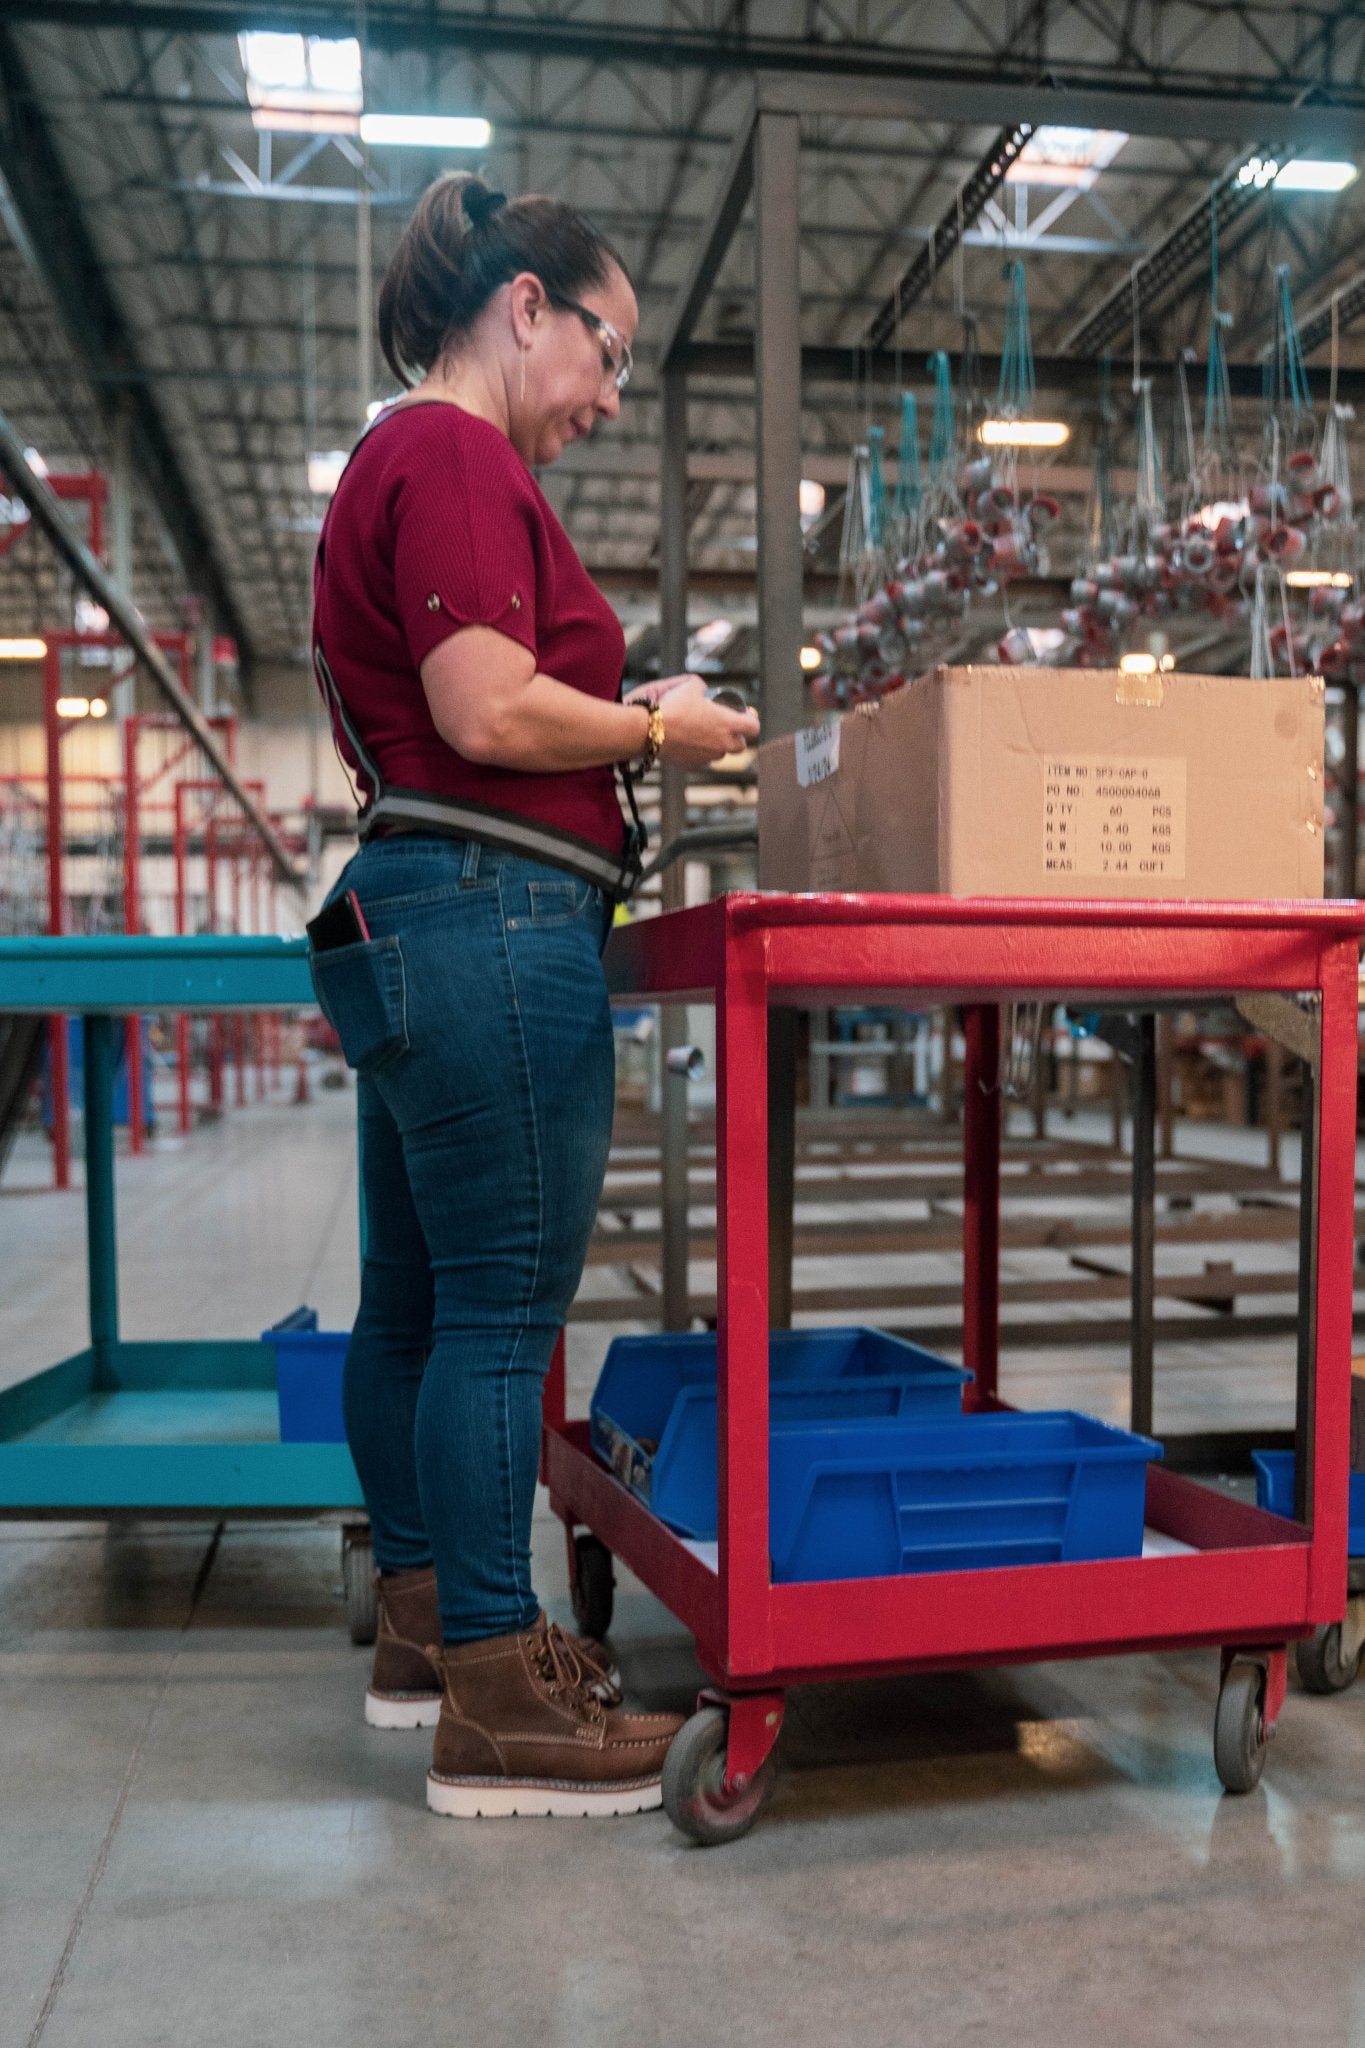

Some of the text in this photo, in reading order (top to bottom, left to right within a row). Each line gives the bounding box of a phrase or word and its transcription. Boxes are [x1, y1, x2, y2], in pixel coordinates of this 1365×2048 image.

[1048, 765, 1070, 777] ITEM
[1047, 784, 1060, 797] PO
[1152, 823, 1171, 836] KGS
[1101, 841, 1131, 854] 10.00
[1152, 841, 1171, 854] KGS
[1103, 859, 1128, 872] 2.44
